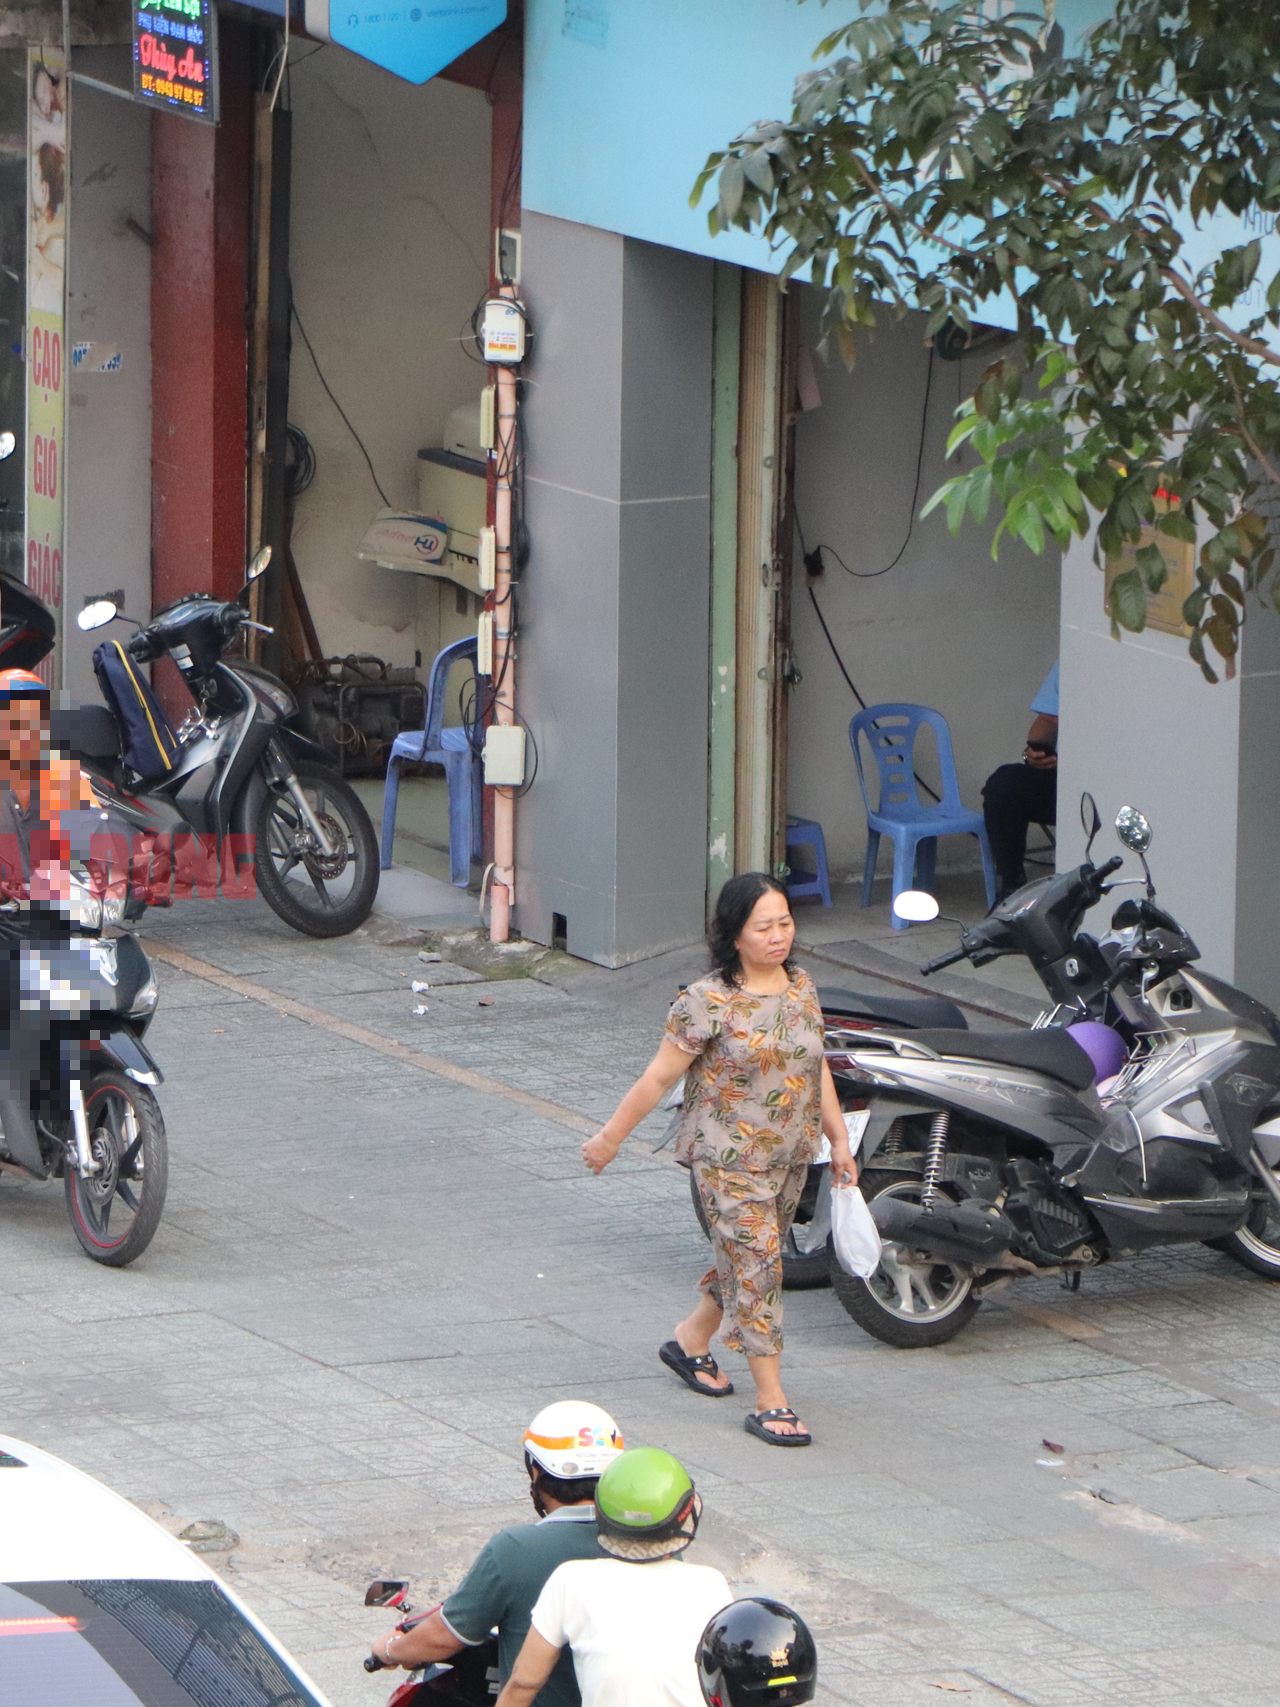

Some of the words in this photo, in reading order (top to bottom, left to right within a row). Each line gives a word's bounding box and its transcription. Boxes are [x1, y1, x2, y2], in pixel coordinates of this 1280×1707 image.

[32, 325, 61, 403] CẠO
[33, 426, 58, 500] GIÓ
[27, 532, 61, 608] GIÁC
